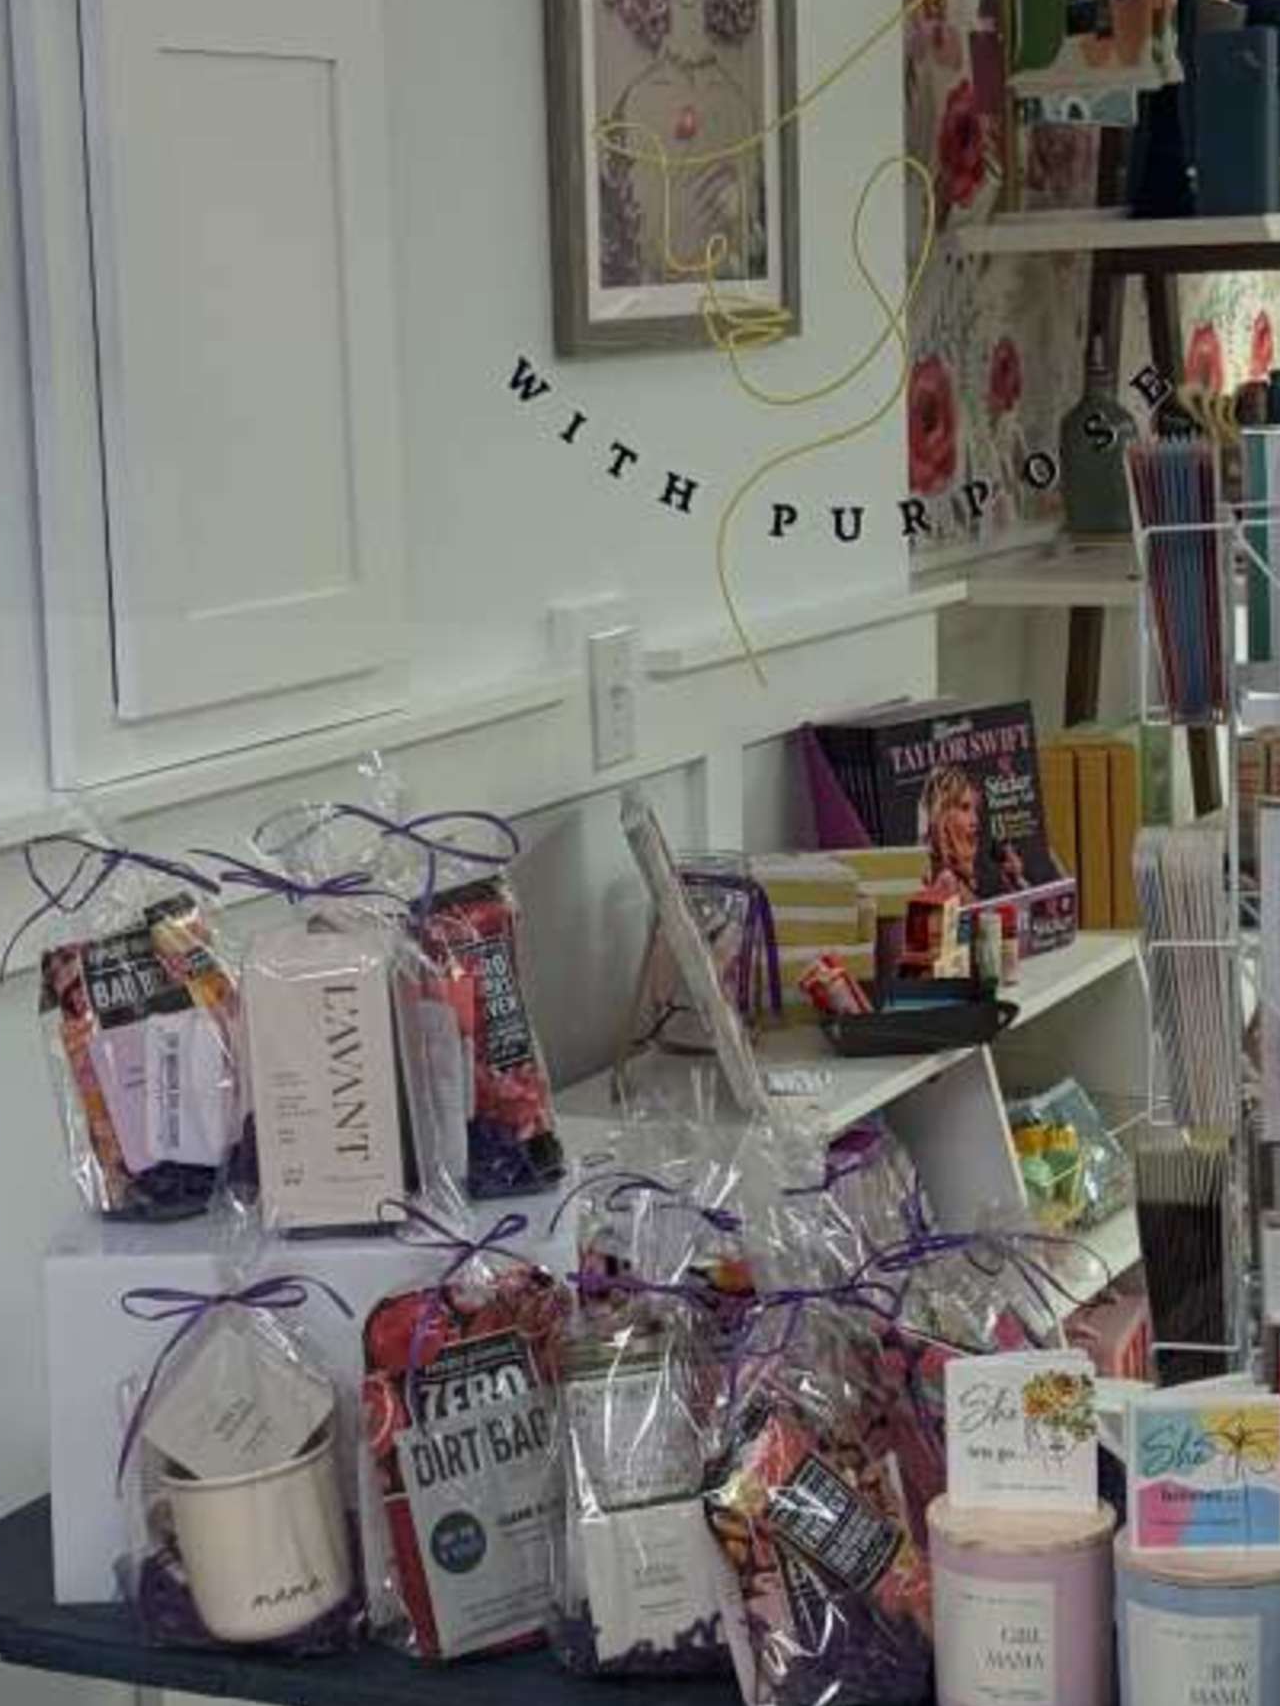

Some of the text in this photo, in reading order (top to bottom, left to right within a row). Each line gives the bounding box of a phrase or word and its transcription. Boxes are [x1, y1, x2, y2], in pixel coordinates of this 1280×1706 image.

[504, 357, 1169, 544] WITH PURPOSE
[890, 733, 967, 772] TAYLOR
[969, 724, 1029, 758] SWIFT
[412, 1426, 482, 1487] DIRT
